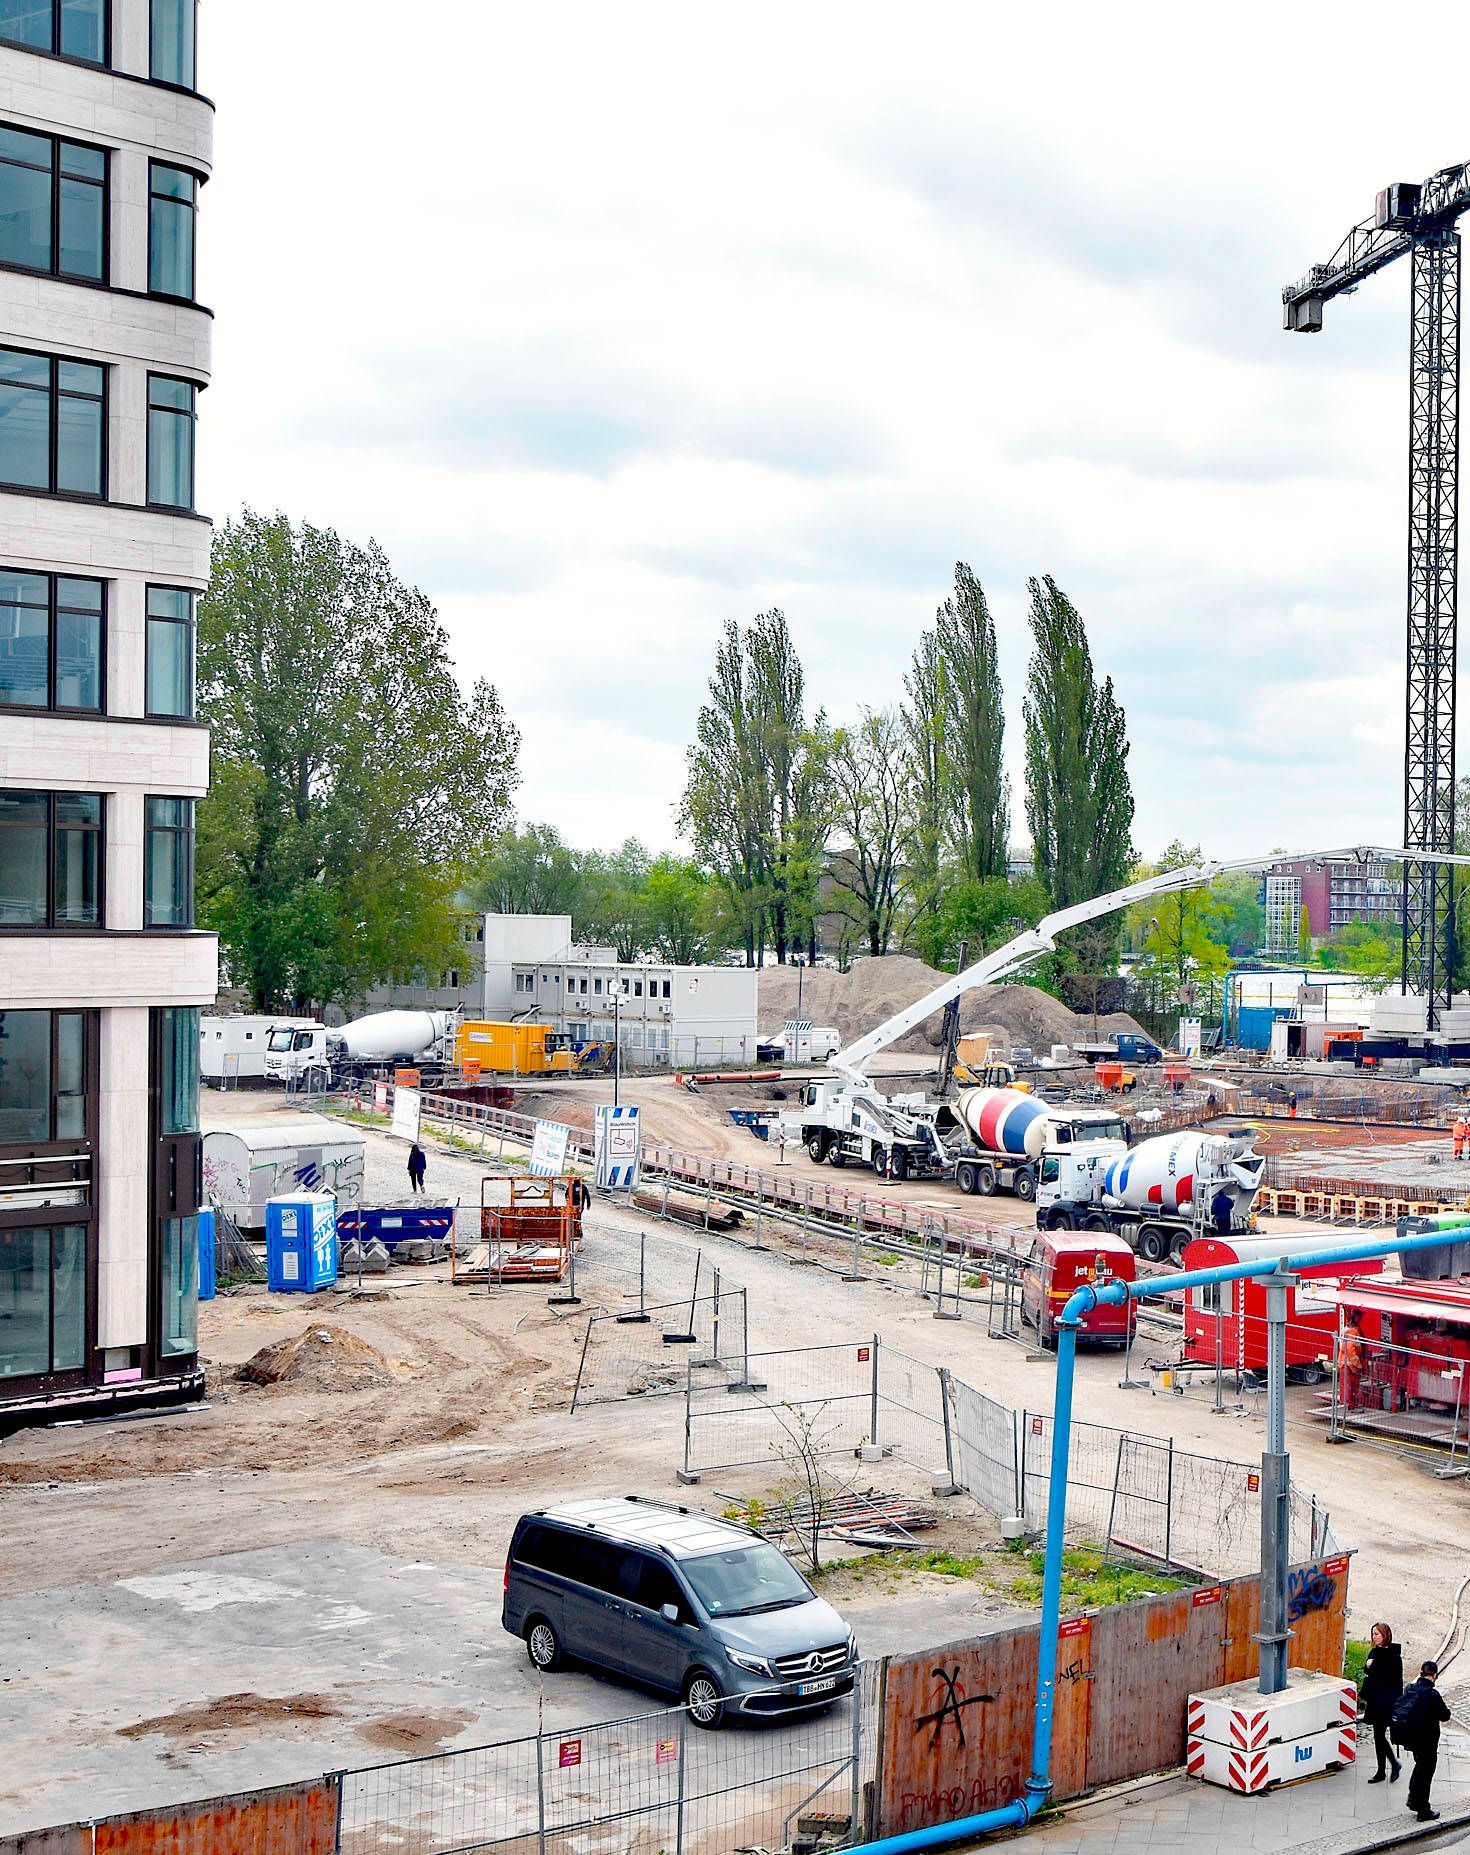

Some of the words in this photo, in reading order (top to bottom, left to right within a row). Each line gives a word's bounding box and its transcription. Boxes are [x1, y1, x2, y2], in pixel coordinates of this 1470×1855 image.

[1168, 1141, 1182, 1177] CEMEX
[1075, 1266, 1088, 1277] jet
[1301, 1281, 1311, 1291] jet
